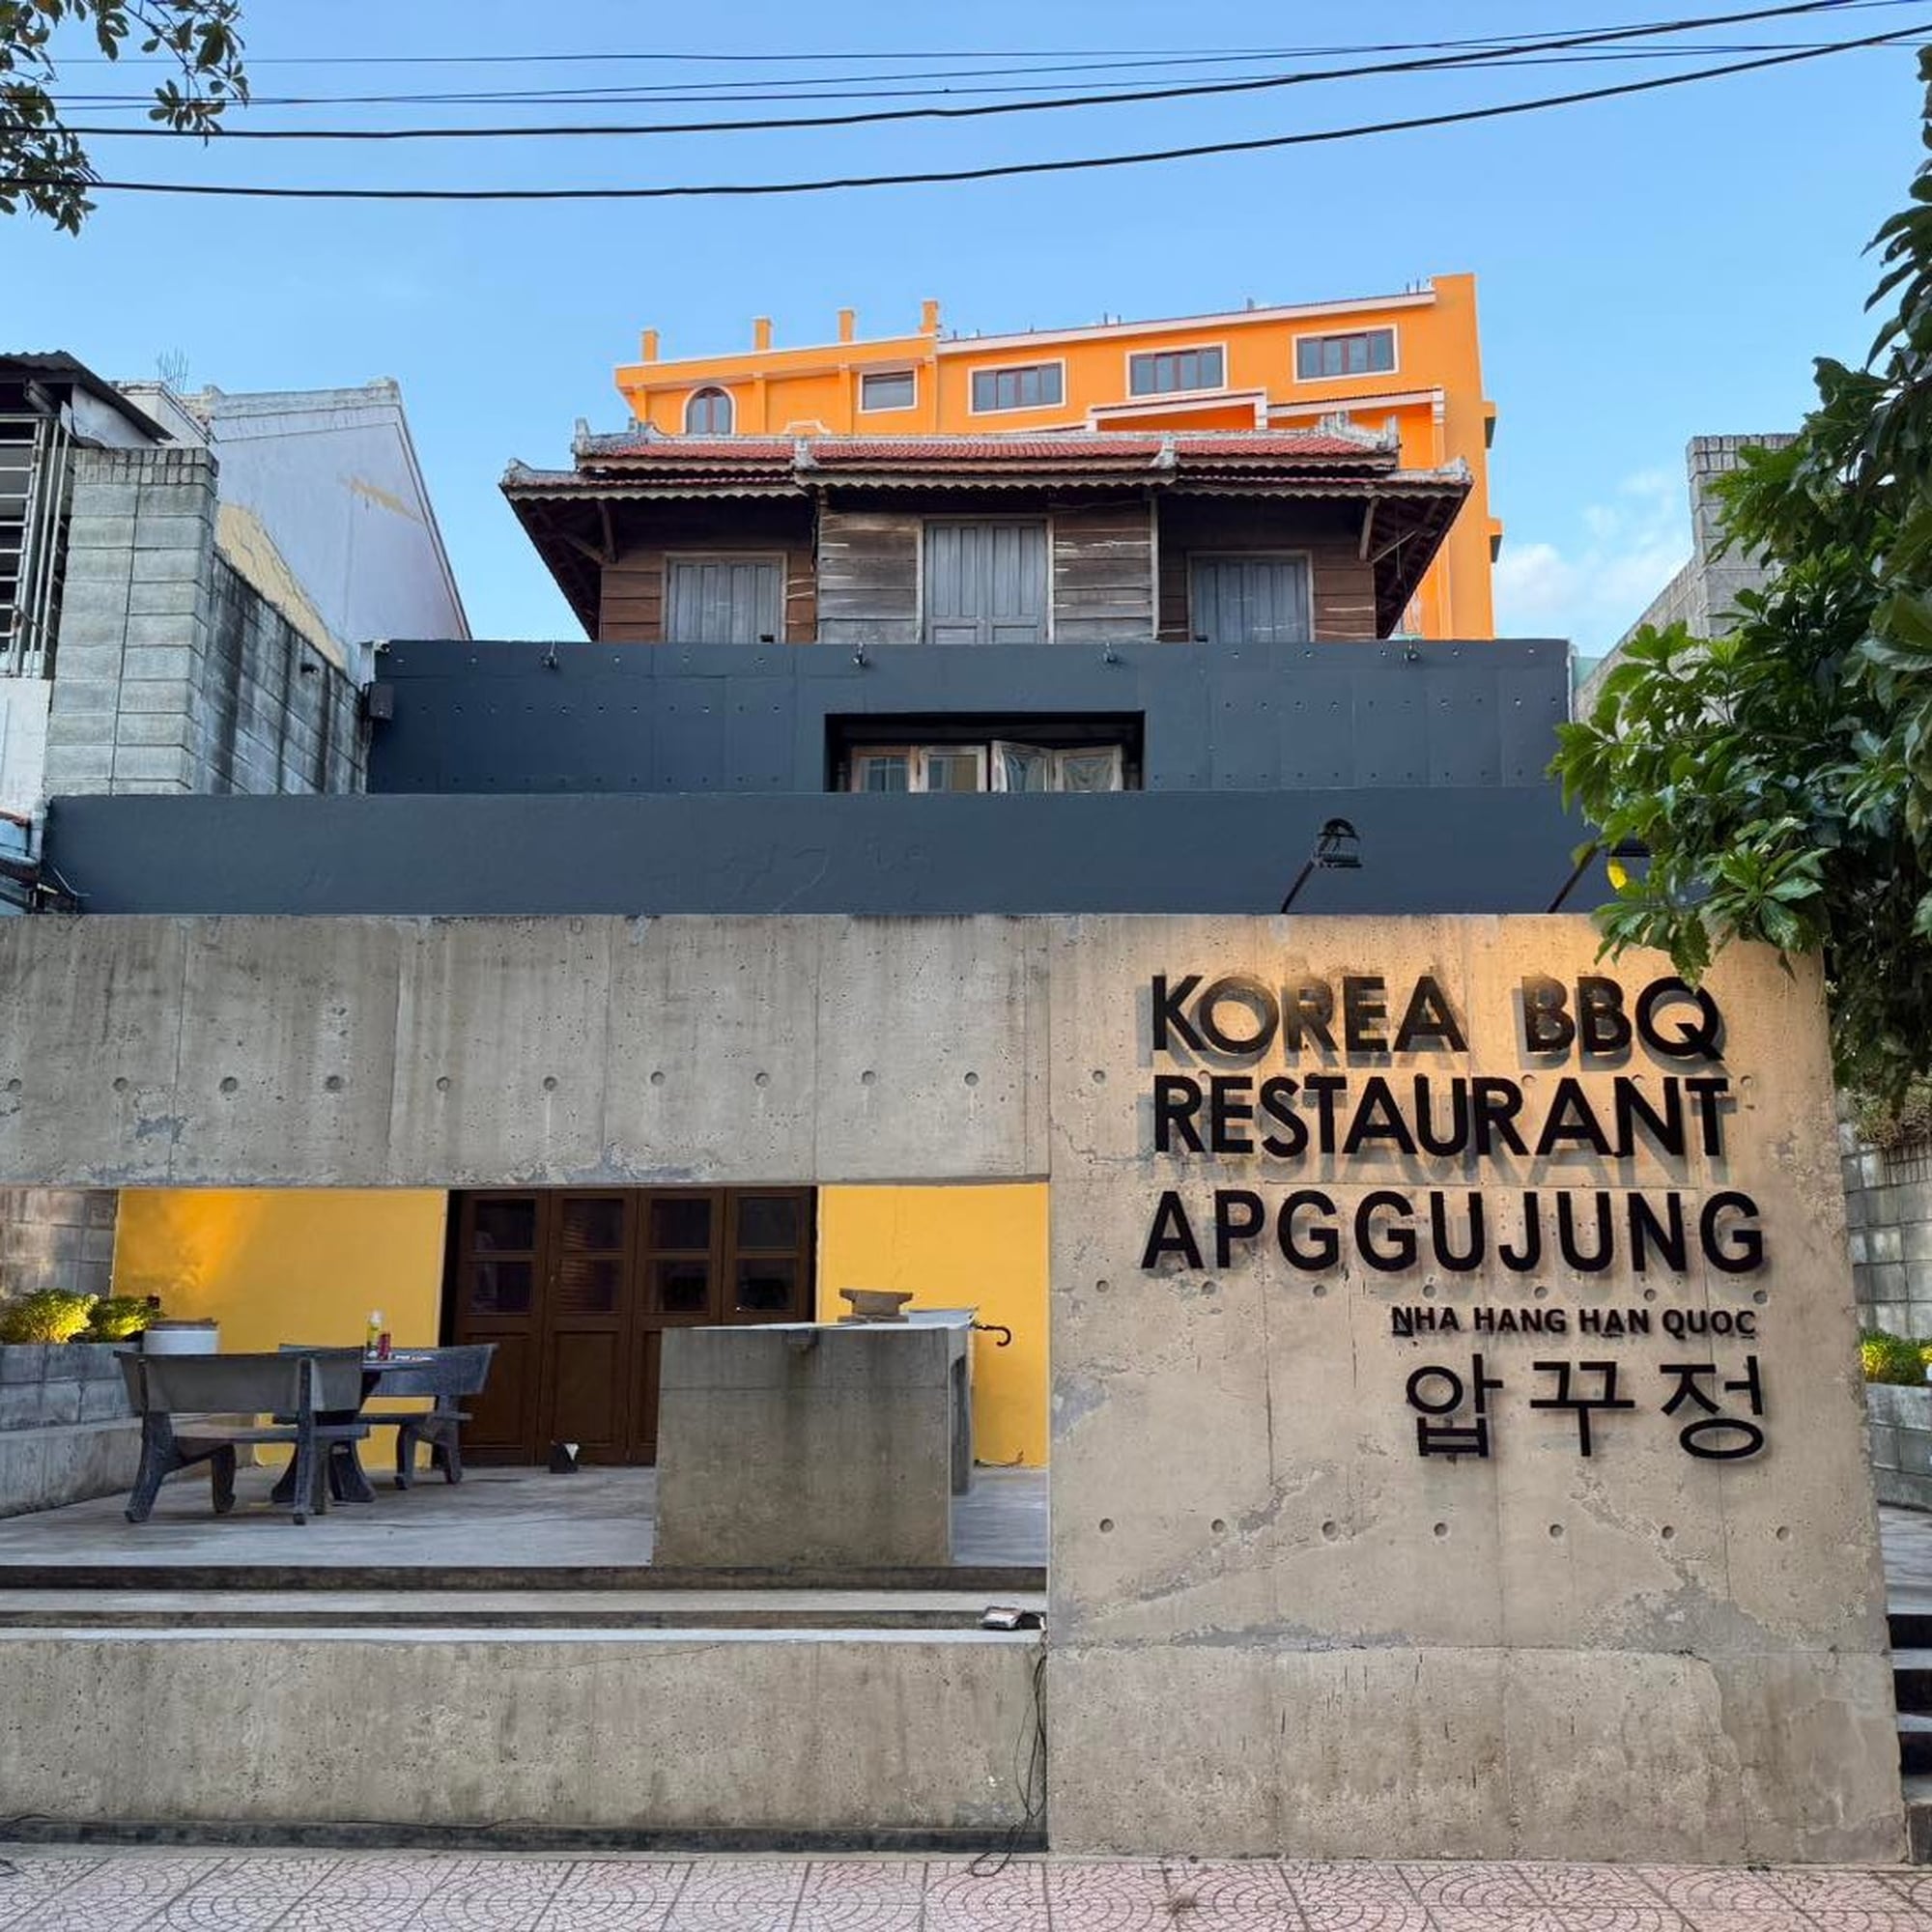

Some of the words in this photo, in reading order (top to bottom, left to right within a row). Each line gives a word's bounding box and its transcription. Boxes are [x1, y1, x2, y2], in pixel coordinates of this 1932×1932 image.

[1152, 976, 1468, 1052] KOREA
[1524, 977, 1725, 1061] BBQ
[1154, 1075, 1728, 1157] RESTAURANT
[1141, 1191, 1763, 1273] APGGUJUNG
[1392, 1307, 1460, 1335] NHA
[1662, 1310, 1756, 1339] QUOC
